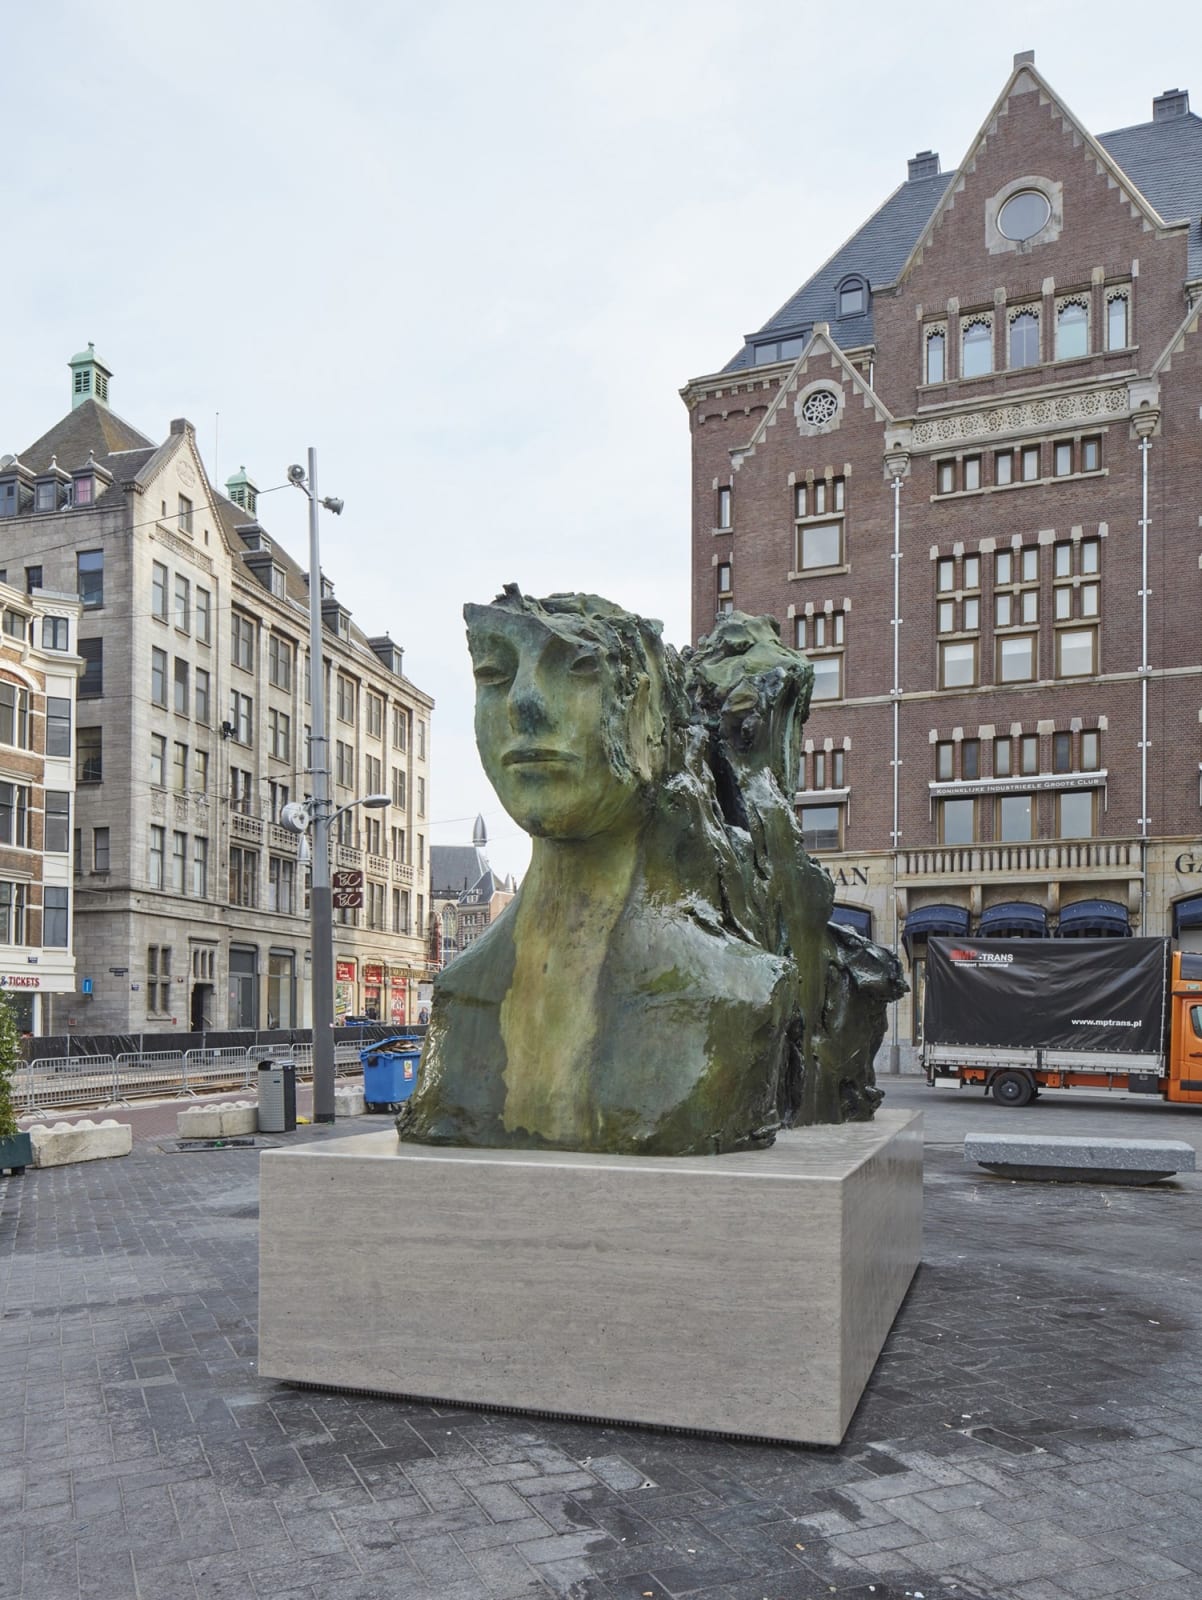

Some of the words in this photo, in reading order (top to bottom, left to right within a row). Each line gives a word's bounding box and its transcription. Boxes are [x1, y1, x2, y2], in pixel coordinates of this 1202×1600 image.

[1044, 780, 1076, 788] GROOTE
[826, 866, 870, 886] AN
[8, 975, 40, 988] TICKETS
[1071, 1019, 1142, 1028] www.mptrans.pl
